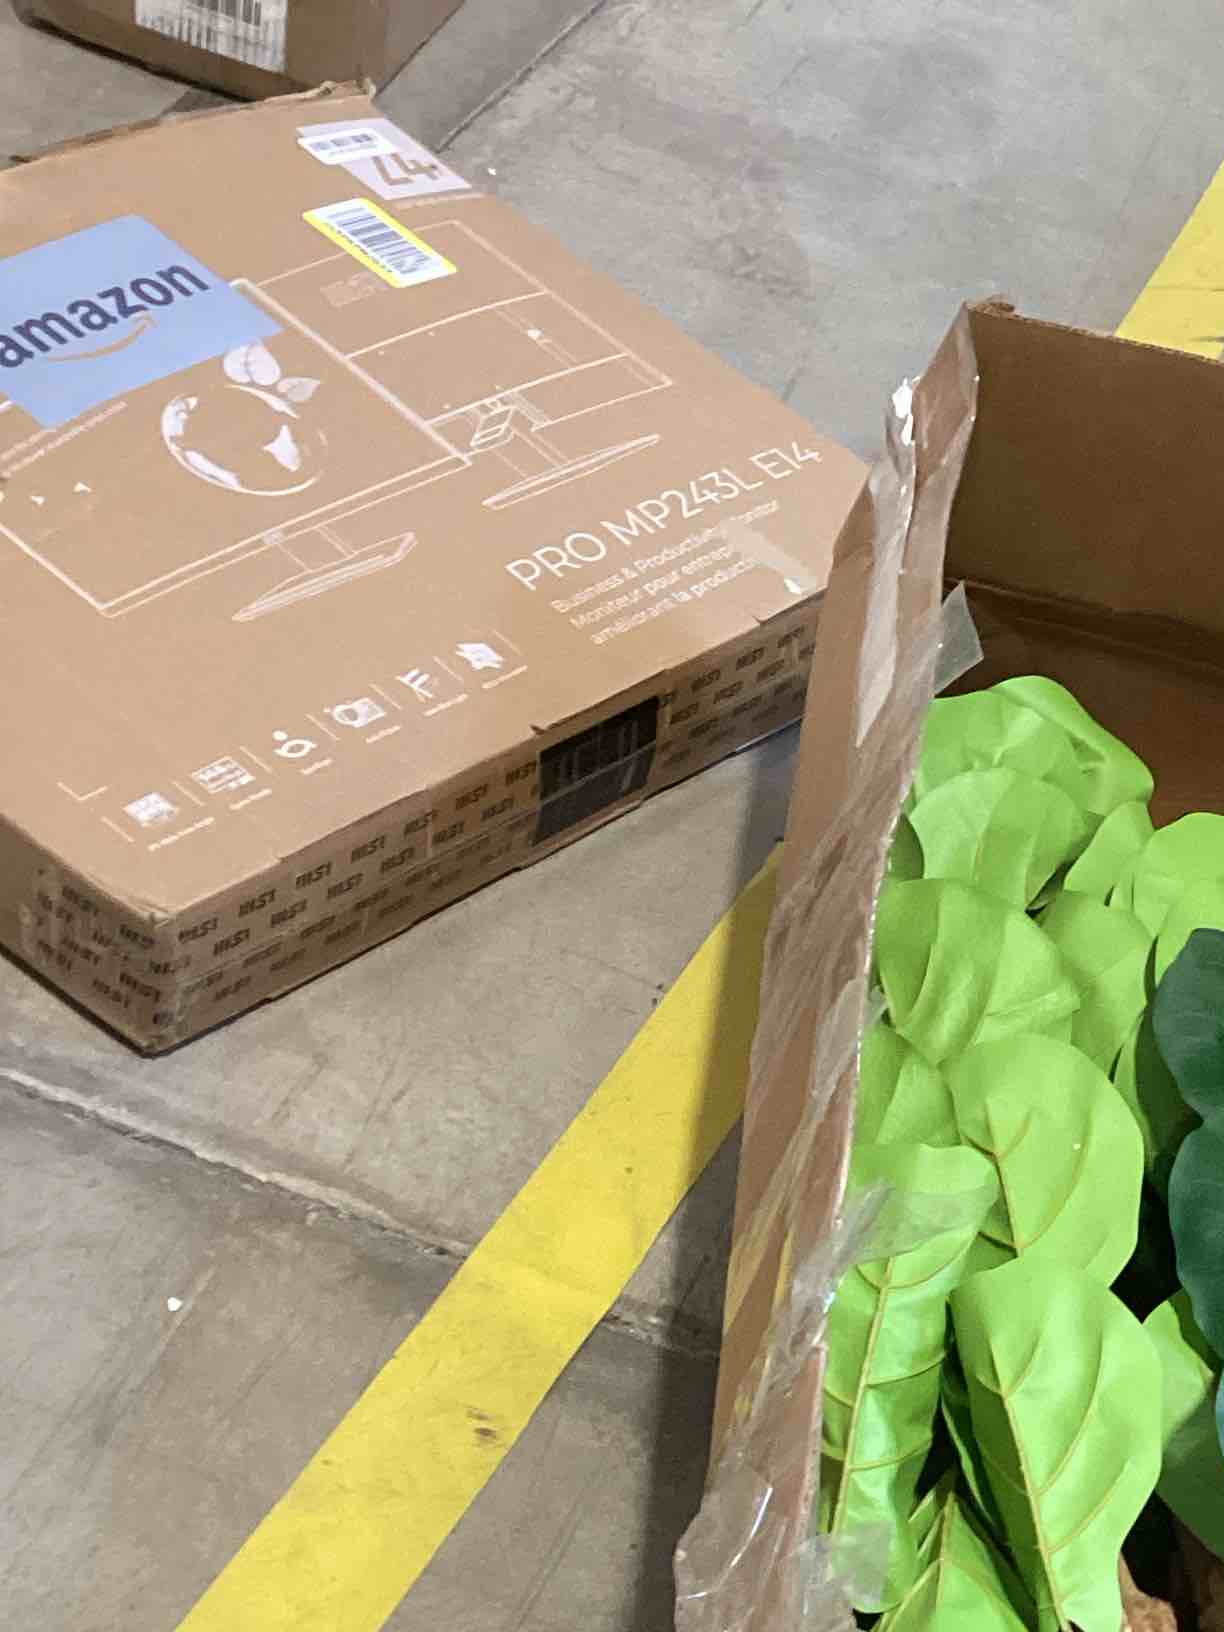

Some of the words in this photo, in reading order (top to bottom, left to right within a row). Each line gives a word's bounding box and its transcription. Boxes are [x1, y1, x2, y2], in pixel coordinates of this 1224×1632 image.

[0, 265, 209, 368] amazon
[505, 532, 607, 591] PRO
[600, 468, 764, 546] MP243L
[750, 441, 822, 480] E14
